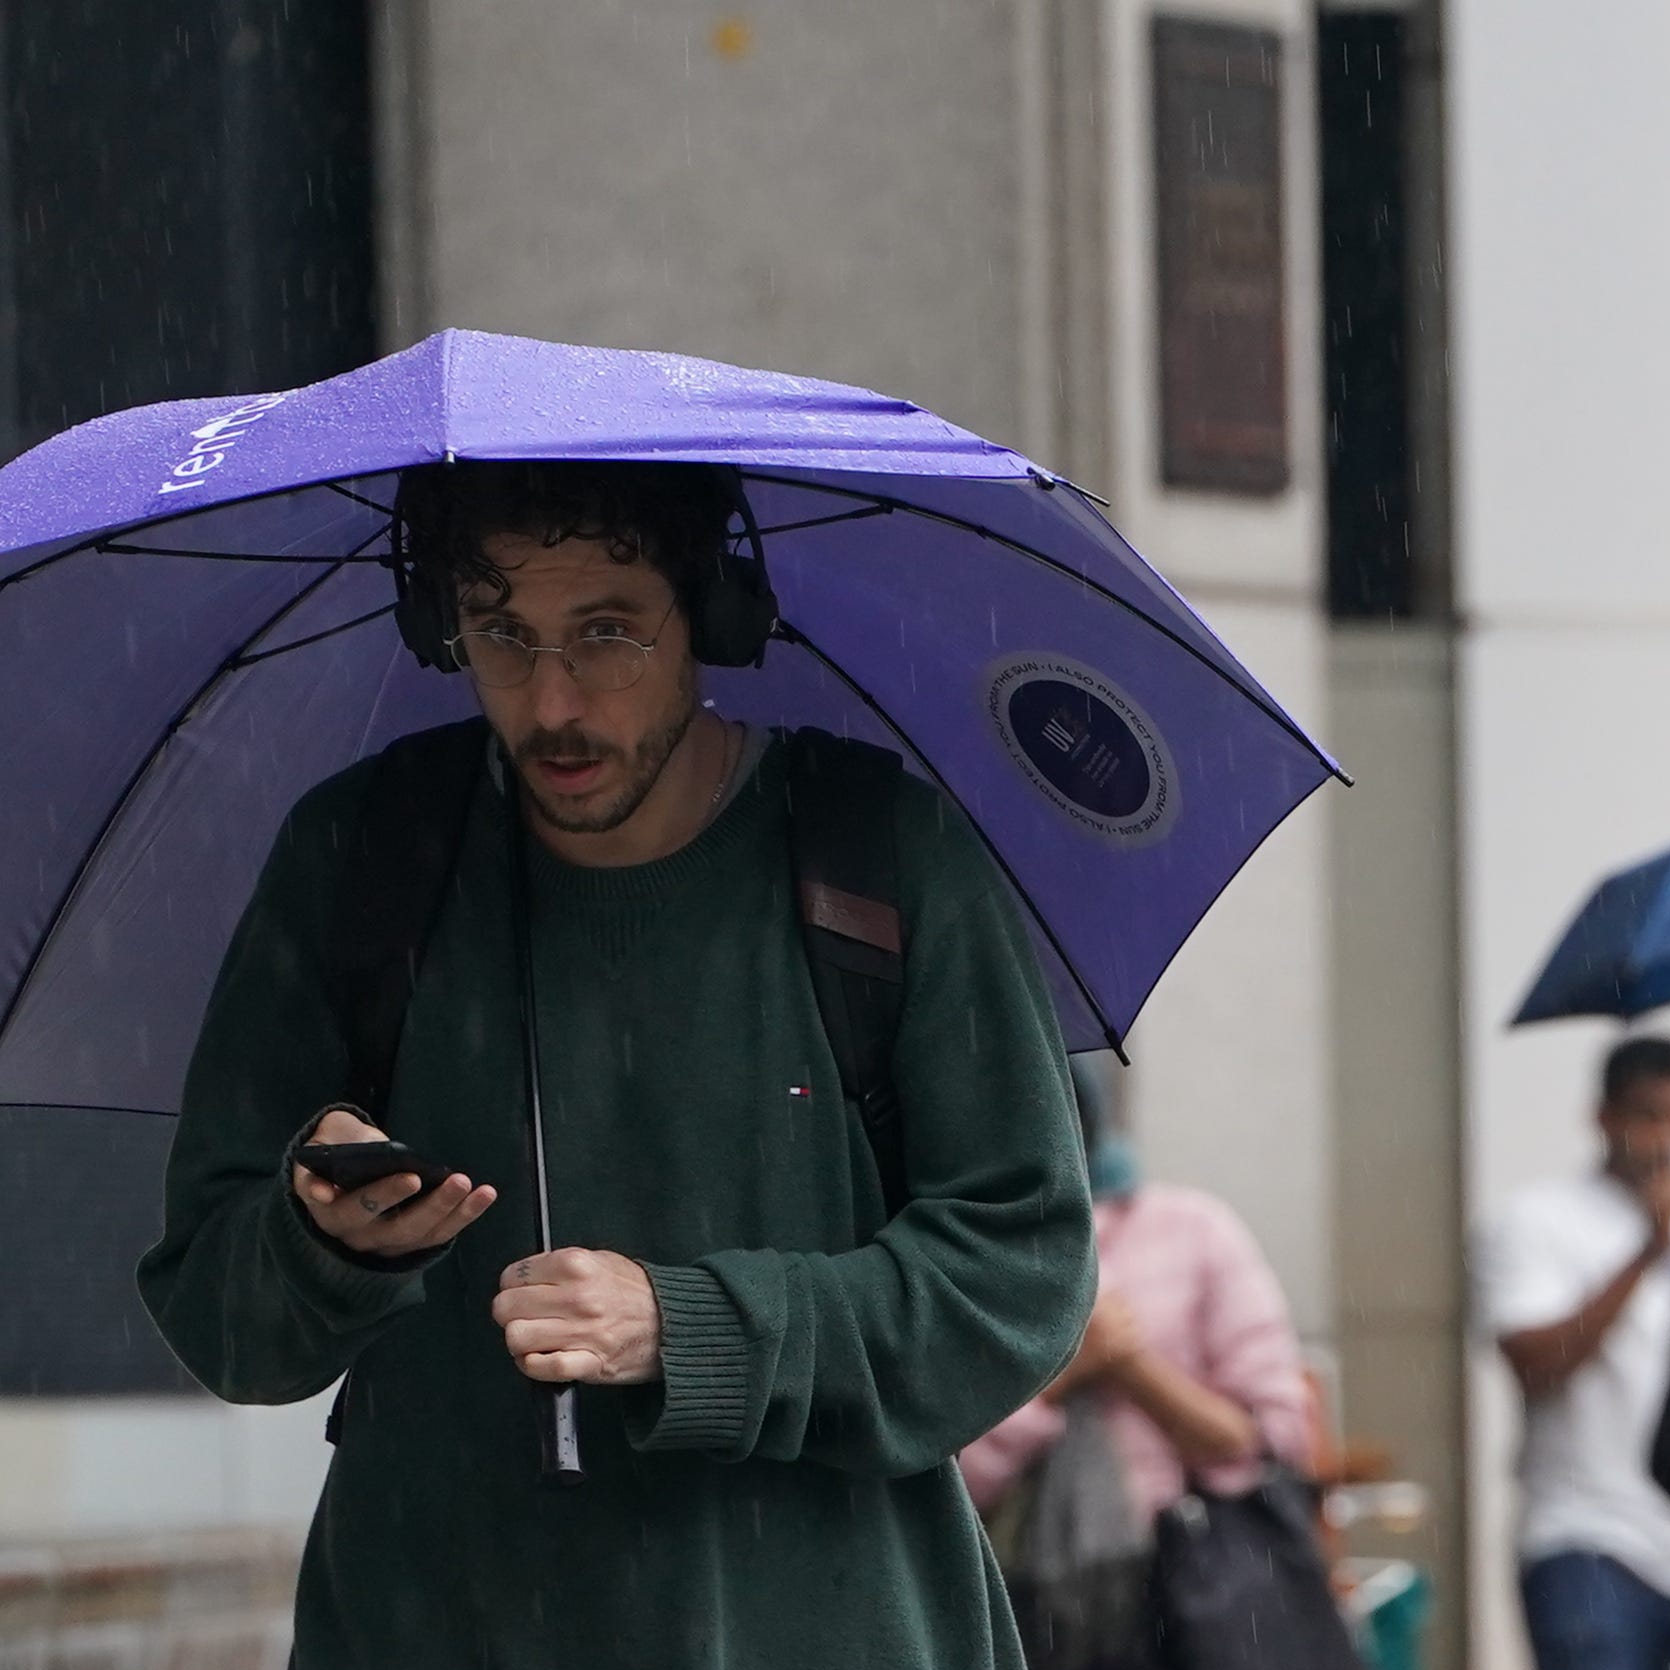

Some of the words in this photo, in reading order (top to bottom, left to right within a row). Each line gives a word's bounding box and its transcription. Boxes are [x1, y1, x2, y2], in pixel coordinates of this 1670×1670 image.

[1055, 665, 1094, 686] ALSO
[1097, 684, 1154, 741] PROTECT
[1041, 718, 1075, 752] UV
[1150, 744, 1165, 775] YOU
[1155, 776, 1167, 814] FROM
[1118, 823, 1144, 835] SUN
[1140, 811, 1161, 830] THE
